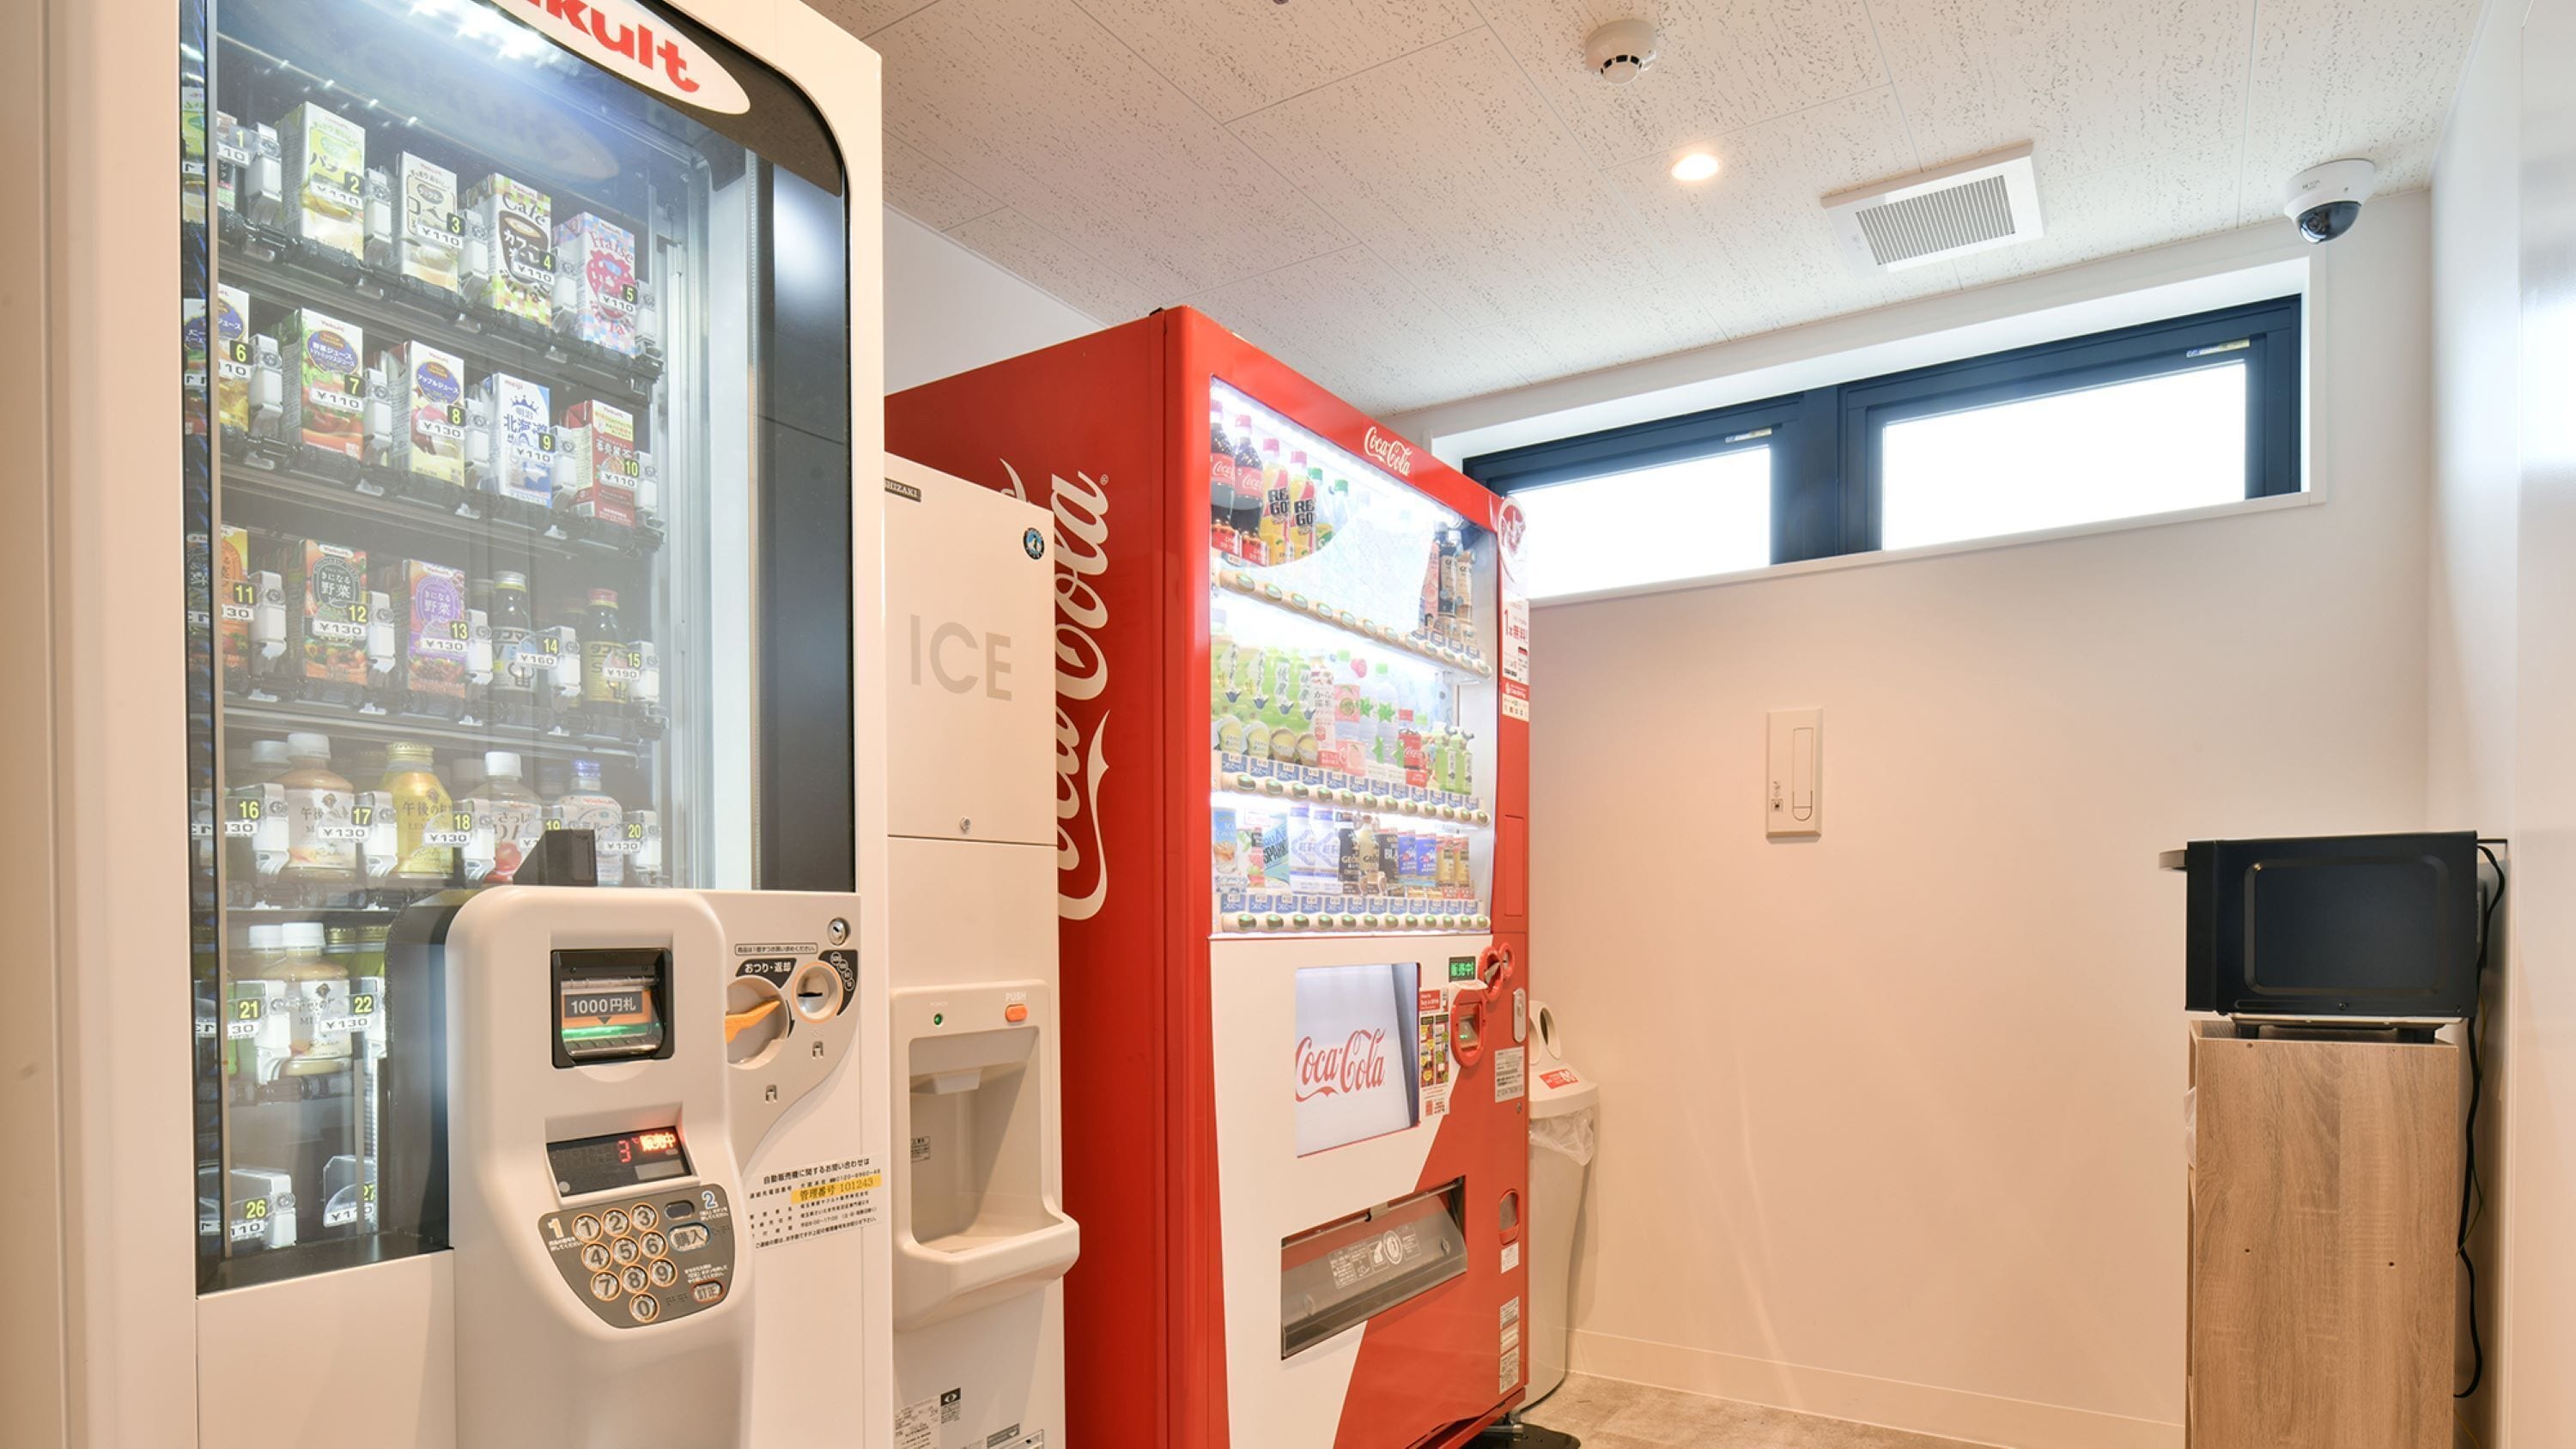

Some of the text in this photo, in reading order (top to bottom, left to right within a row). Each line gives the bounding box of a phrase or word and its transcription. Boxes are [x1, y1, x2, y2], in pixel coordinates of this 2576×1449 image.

[525, 0, 700, 94] kult
[235, 130, 244, 148] 1
[349, 175, 360, 194] 2
[452, 216, 460, 233] 3
[544, 255, 551, 270] 4
[626, 286, 635, 302] 5
[236, 345, 247, 362] 6
[350, 376, 360, 395] 7
[452, 408, 461, 425] 8
[542, 433, 551, 451] 9
[1364, 425, 1413, 477] Coca-Cola
[624, 460, 639, 477] 10
[234, 584, 253, 604] 11
[348, 603, 368, 624] 12
[452, 621, 469, 640] 13
[544, 638, 558, 654] 14
[628, 652, 641, 668] 15
[910, 614, 1012, 701] ICE
[240, 800, 259, 820] 16
[353, 807, 372, 825] 17
[454, 814, 471, 832] 18
[628, 823, 641, 839] 20
[354, 996, 373, 1014] 22
[570, 997, 636, 1015] 1000円札
[1005, 992, 1027, 1002] PUSH
[240, 1001, 258, 1020] 21
[1295, 1028, 1387, 1102] Coca-Cola
[799, 1185, 836, 1202] 管理番号
[839, 1177, 875, 1193] 101243
[246, 1199, 266, 1220] 26
[701, 1191, 719, 1210] 2
[608, 1215, 623, 1232] 2
[637, 1210, 651, 1226] 3
[547, 1217, 565, 1239] 1
[580, 1221, 592, 1237] 1
[619, 1243, 633, 1260] 5
[647, 1237, 659, 1255] 6
[589, 1248, 604, 1266] 4
[627, 1271, 641, 1289] 8
[655, 1264, 668, 1282] 9
[598, 1278, 611, 1296] 7
[637, 1299, 650, 1317] 0
